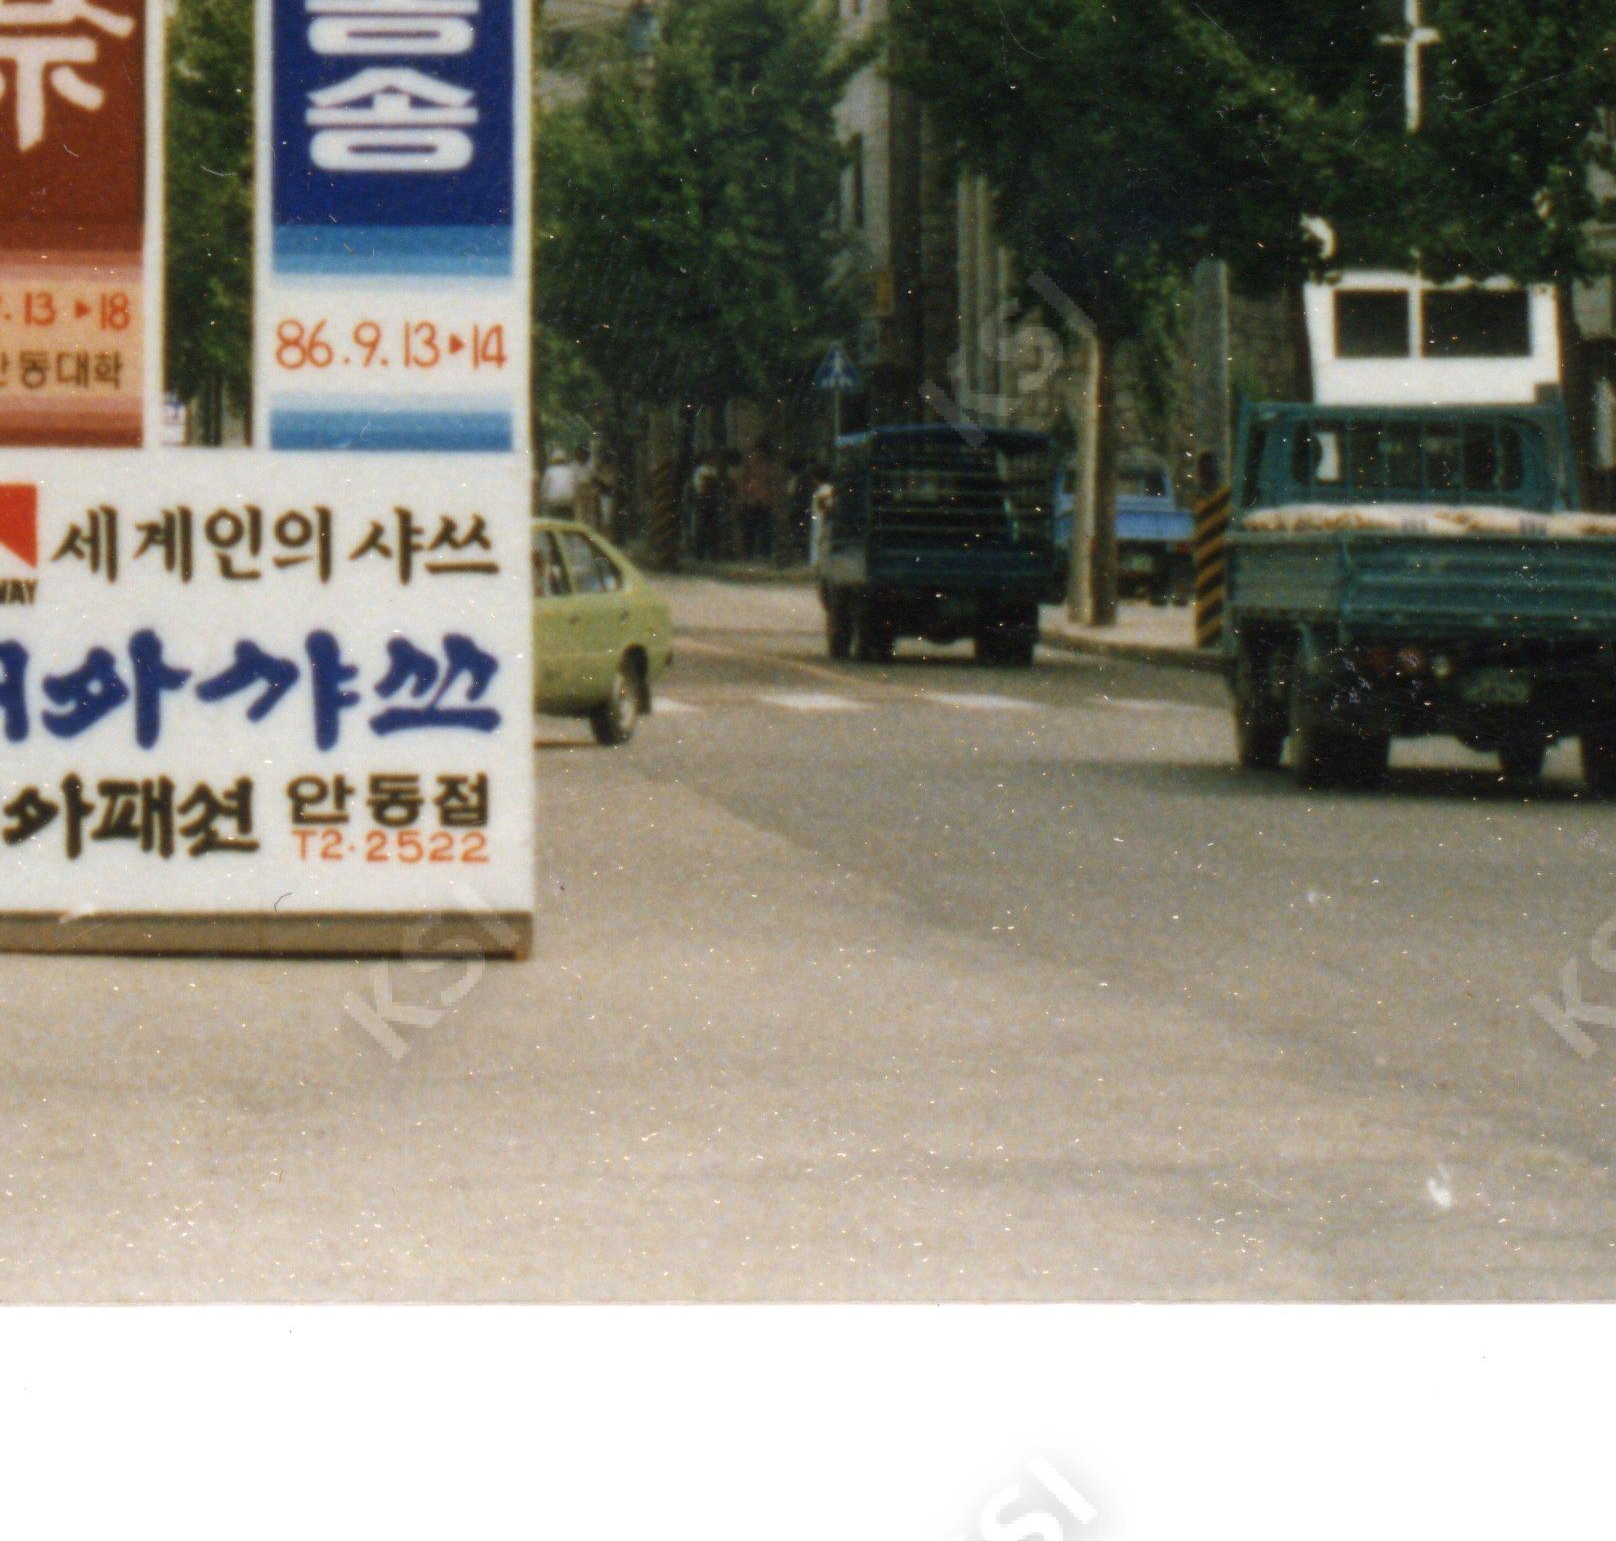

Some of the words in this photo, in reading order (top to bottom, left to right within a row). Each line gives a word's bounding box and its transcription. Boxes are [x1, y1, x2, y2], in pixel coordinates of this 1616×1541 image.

[53, 505, 332, 583] 세계인의
[349, 507, 500, 585] 샤쓰
[286, 774, 490, 827] 안동점
